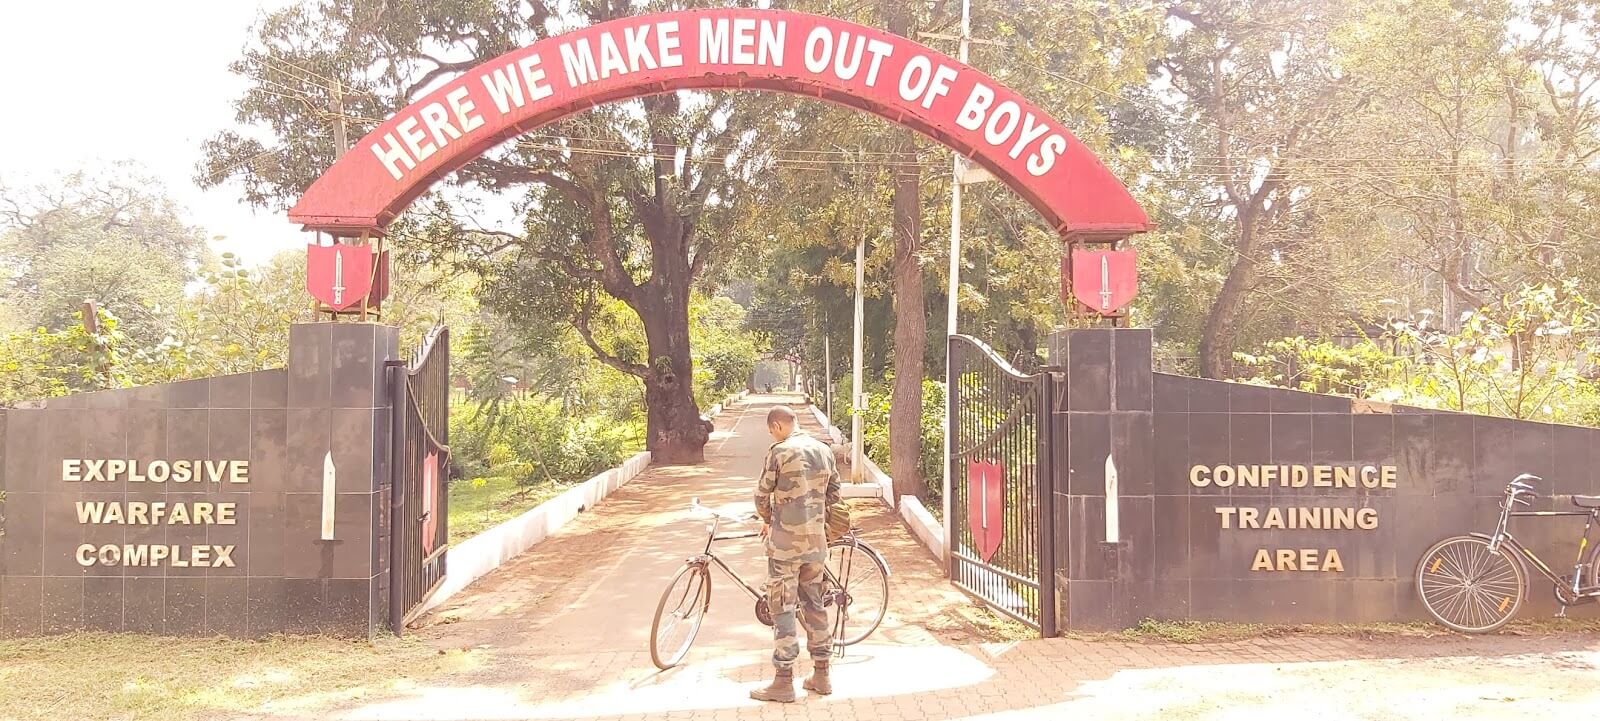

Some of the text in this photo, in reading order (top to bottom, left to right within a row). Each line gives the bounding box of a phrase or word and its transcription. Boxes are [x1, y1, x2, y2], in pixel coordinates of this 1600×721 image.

[370, 18, 1067, 181] HERE WE MAKE MEN OUT OF BOYS
[62, 459, 249, 483] EXPLOSIVE
[1189, 464, 1397, 488] CONFIDENCE
[75, 502, 236, 525] WARFARE
[1215, 507, 1379, 530] TRAINING
[76, 543, 236, 568] COMPLEX
[1251, 549, 1344, 572] AREA
